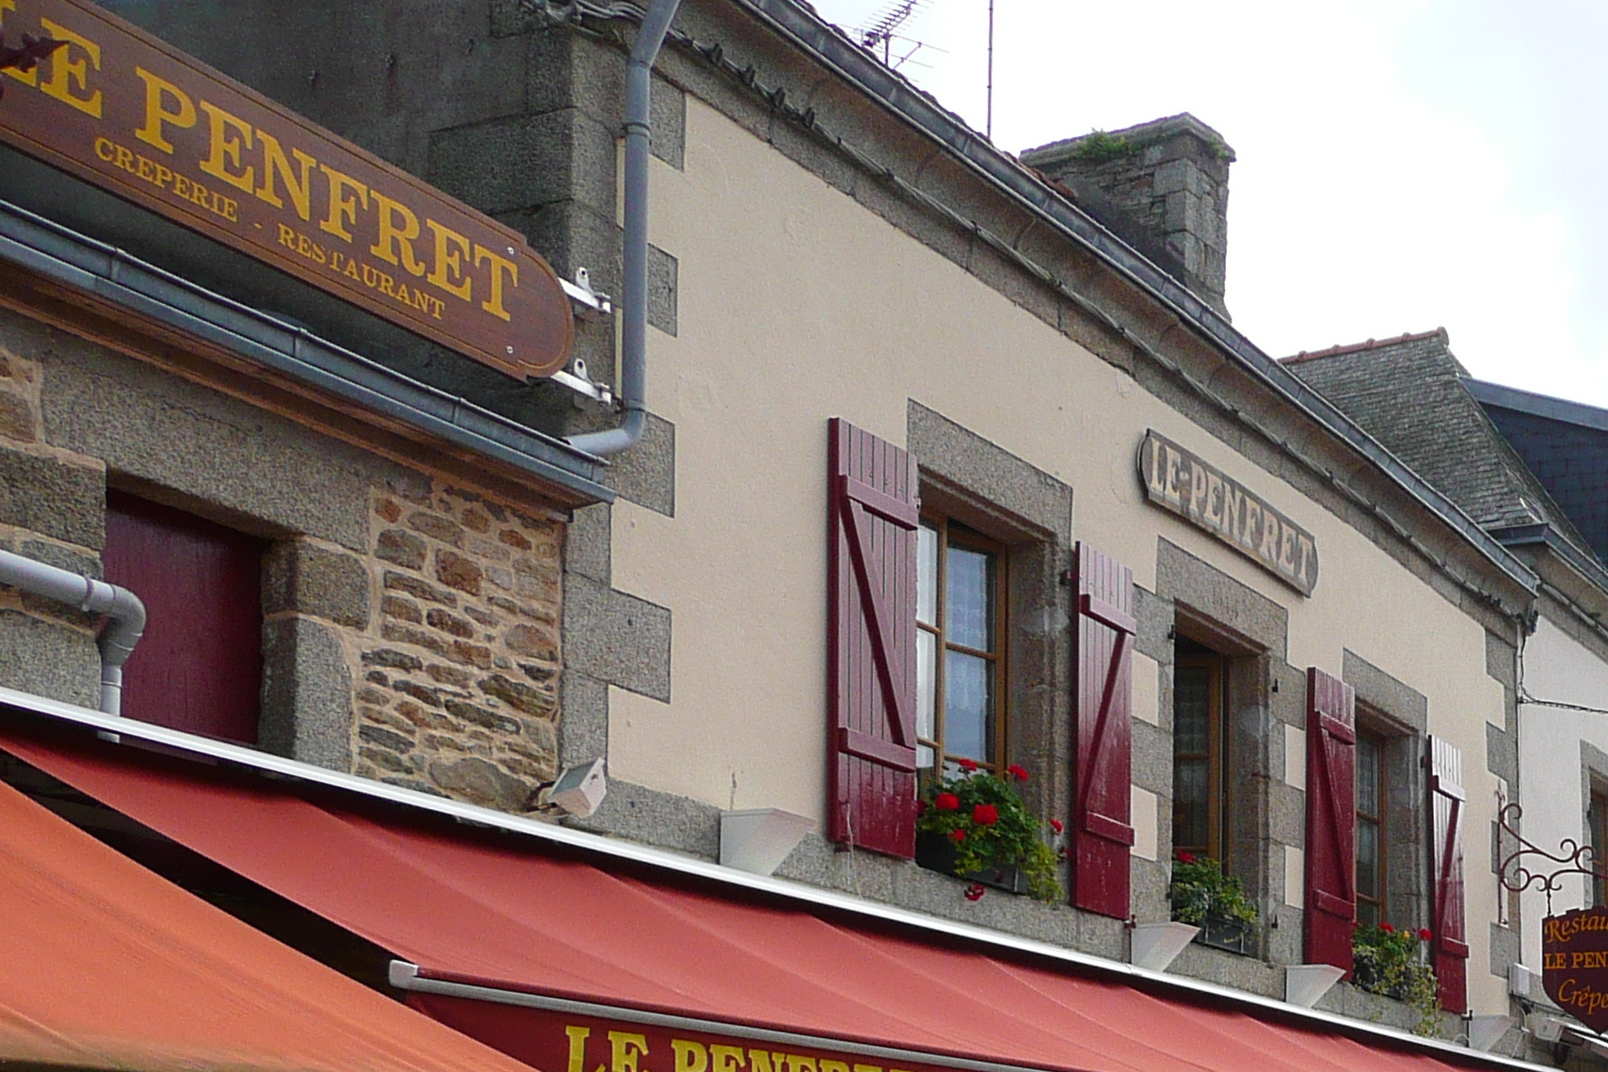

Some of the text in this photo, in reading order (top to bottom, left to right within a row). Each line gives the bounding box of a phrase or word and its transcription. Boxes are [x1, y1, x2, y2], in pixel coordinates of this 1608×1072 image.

[93, 136, 238, 224] CREPERIE
[277, 222, 447, 322] RESTAURANT
[135, 65, 519, 322] PENFRET
[1150, 436, 1314, 588] LE PENFRET
[1544, 952, 1567, 969] LE
